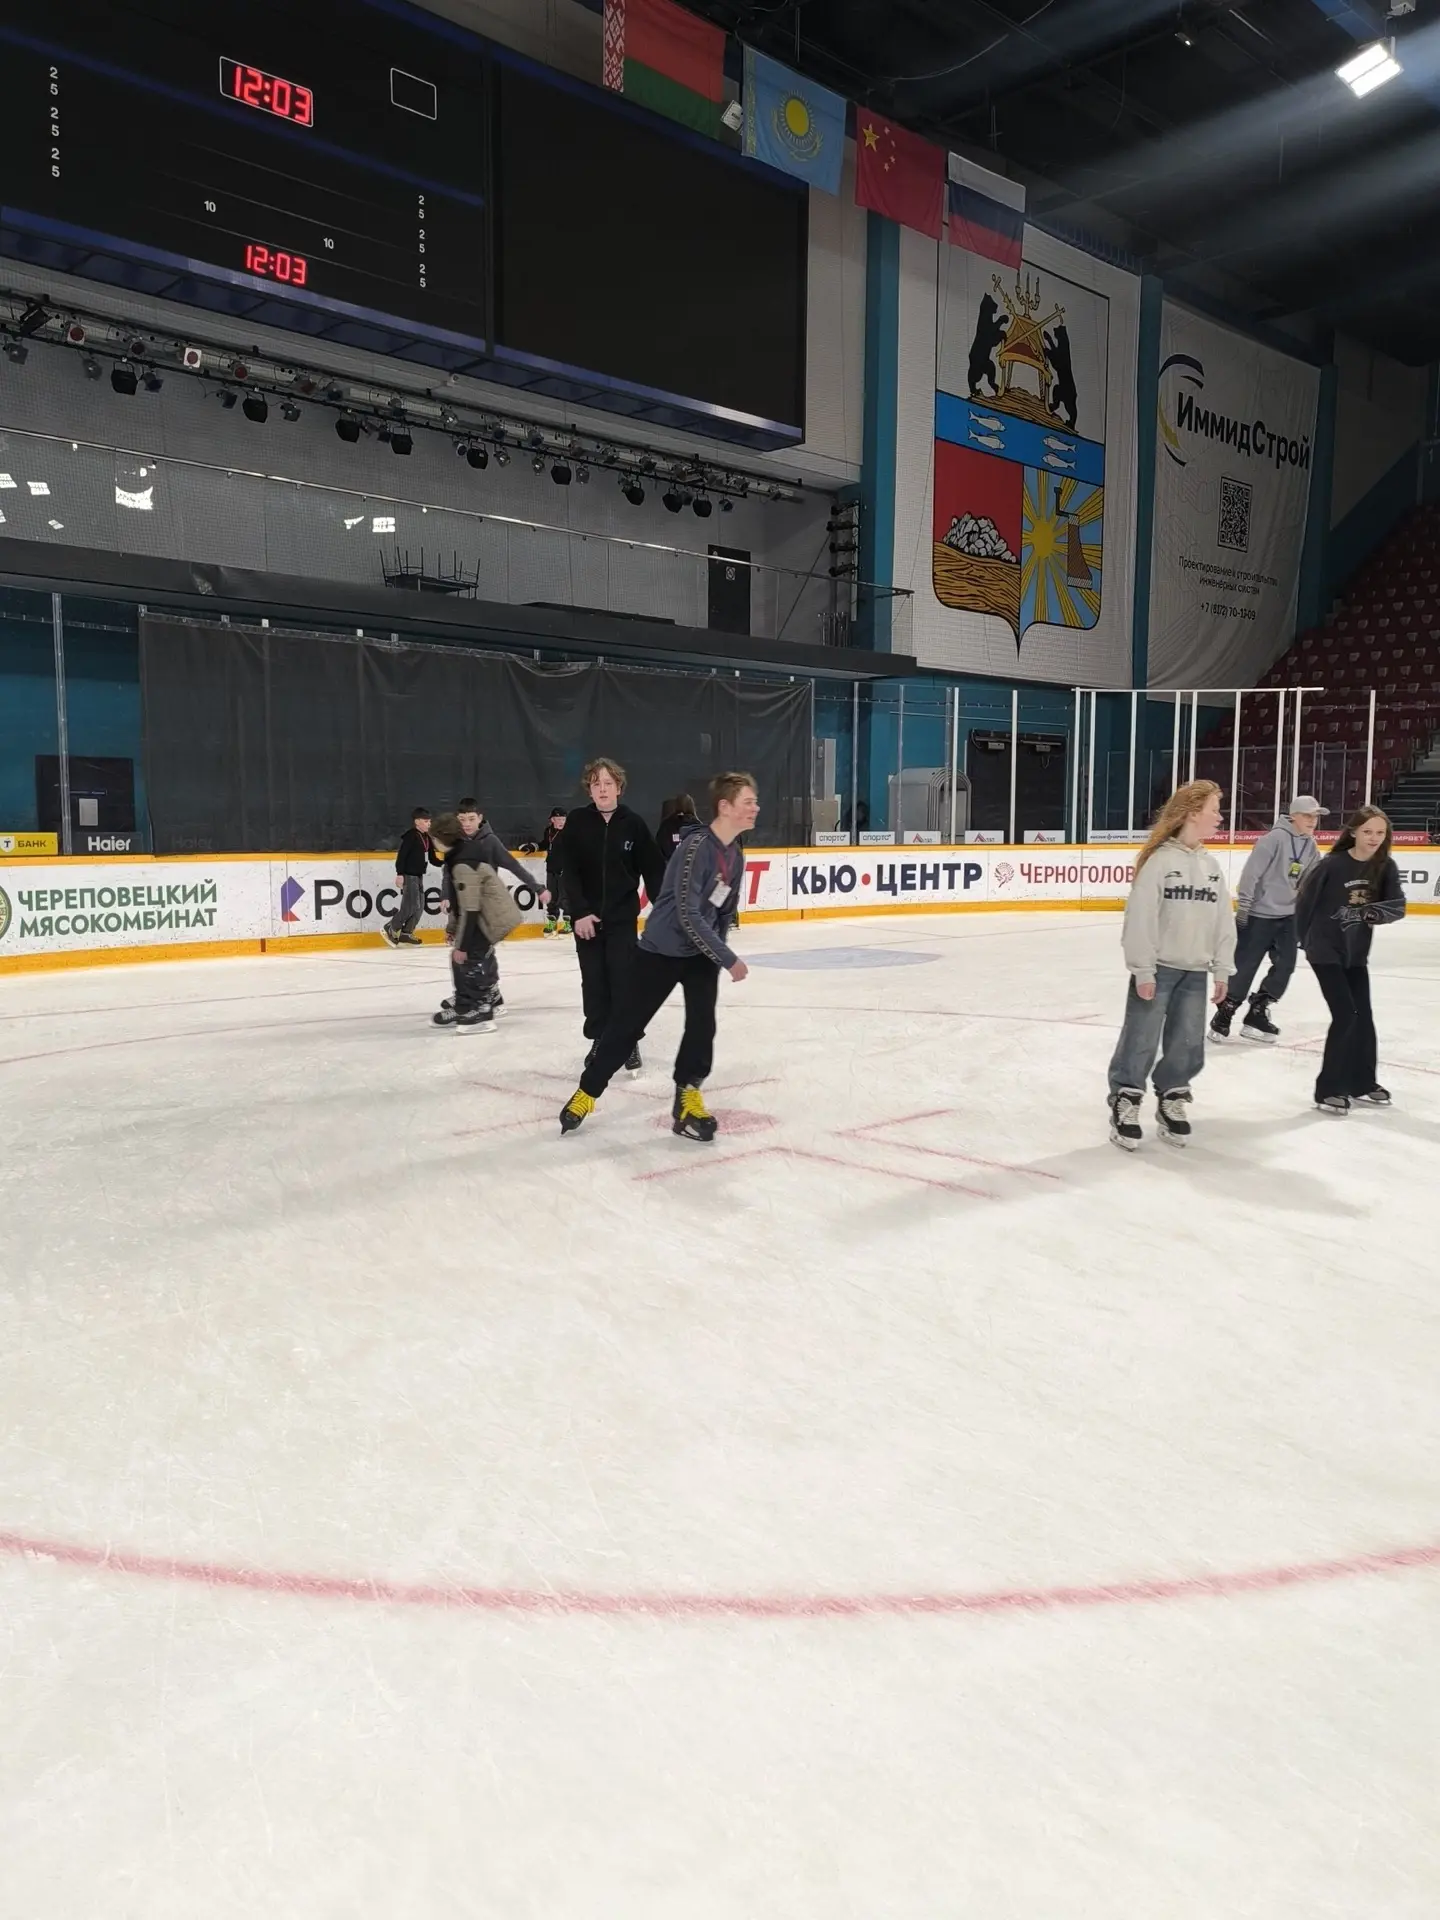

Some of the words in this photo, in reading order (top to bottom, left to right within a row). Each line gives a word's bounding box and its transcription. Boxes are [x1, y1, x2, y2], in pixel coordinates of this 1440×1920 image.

[49, 66, 59, 80] 2
[50, 82, 59, 96] 5
[233, 67, 312, 125] 12:03
[50, 106, 59, 120] 2
[51, 123, 60, 137] 5
[51, 147, 60, 161] 2
[51, 164, 61, 178] 5
[203, 200, 217, 213] 10
[418, 194, 425, 206] 2
[418, 208, 425, 219] 5
[418, 228, 426, 240] 2
[323, 237, 335, 250] 10
[419, 243, 426, 254] 5
[244, 245, 307, 285] 12:03
[419, 263, 426, 275] 2
[419, 277, 427, 288] 5
[1177, 391, 1310, 470] ИммидСтрой
[1179, 555, 1232, 577] Проектирование
[17, 839, 47, 848] БАНК
[87, 835, 131, 852] Haier
[791, 864, 857, 895] КЬЮ
[876, 862, 983, 896] ЦЕНТР
[1020, 863, 1135, 884] ЧЕРНОГОЛОВ
[18, 878, 217, 912] ЧЕРЕПОВЕЦКИЙ
[20, 908, 217, 938] МЯСОКОМБИНАТ
